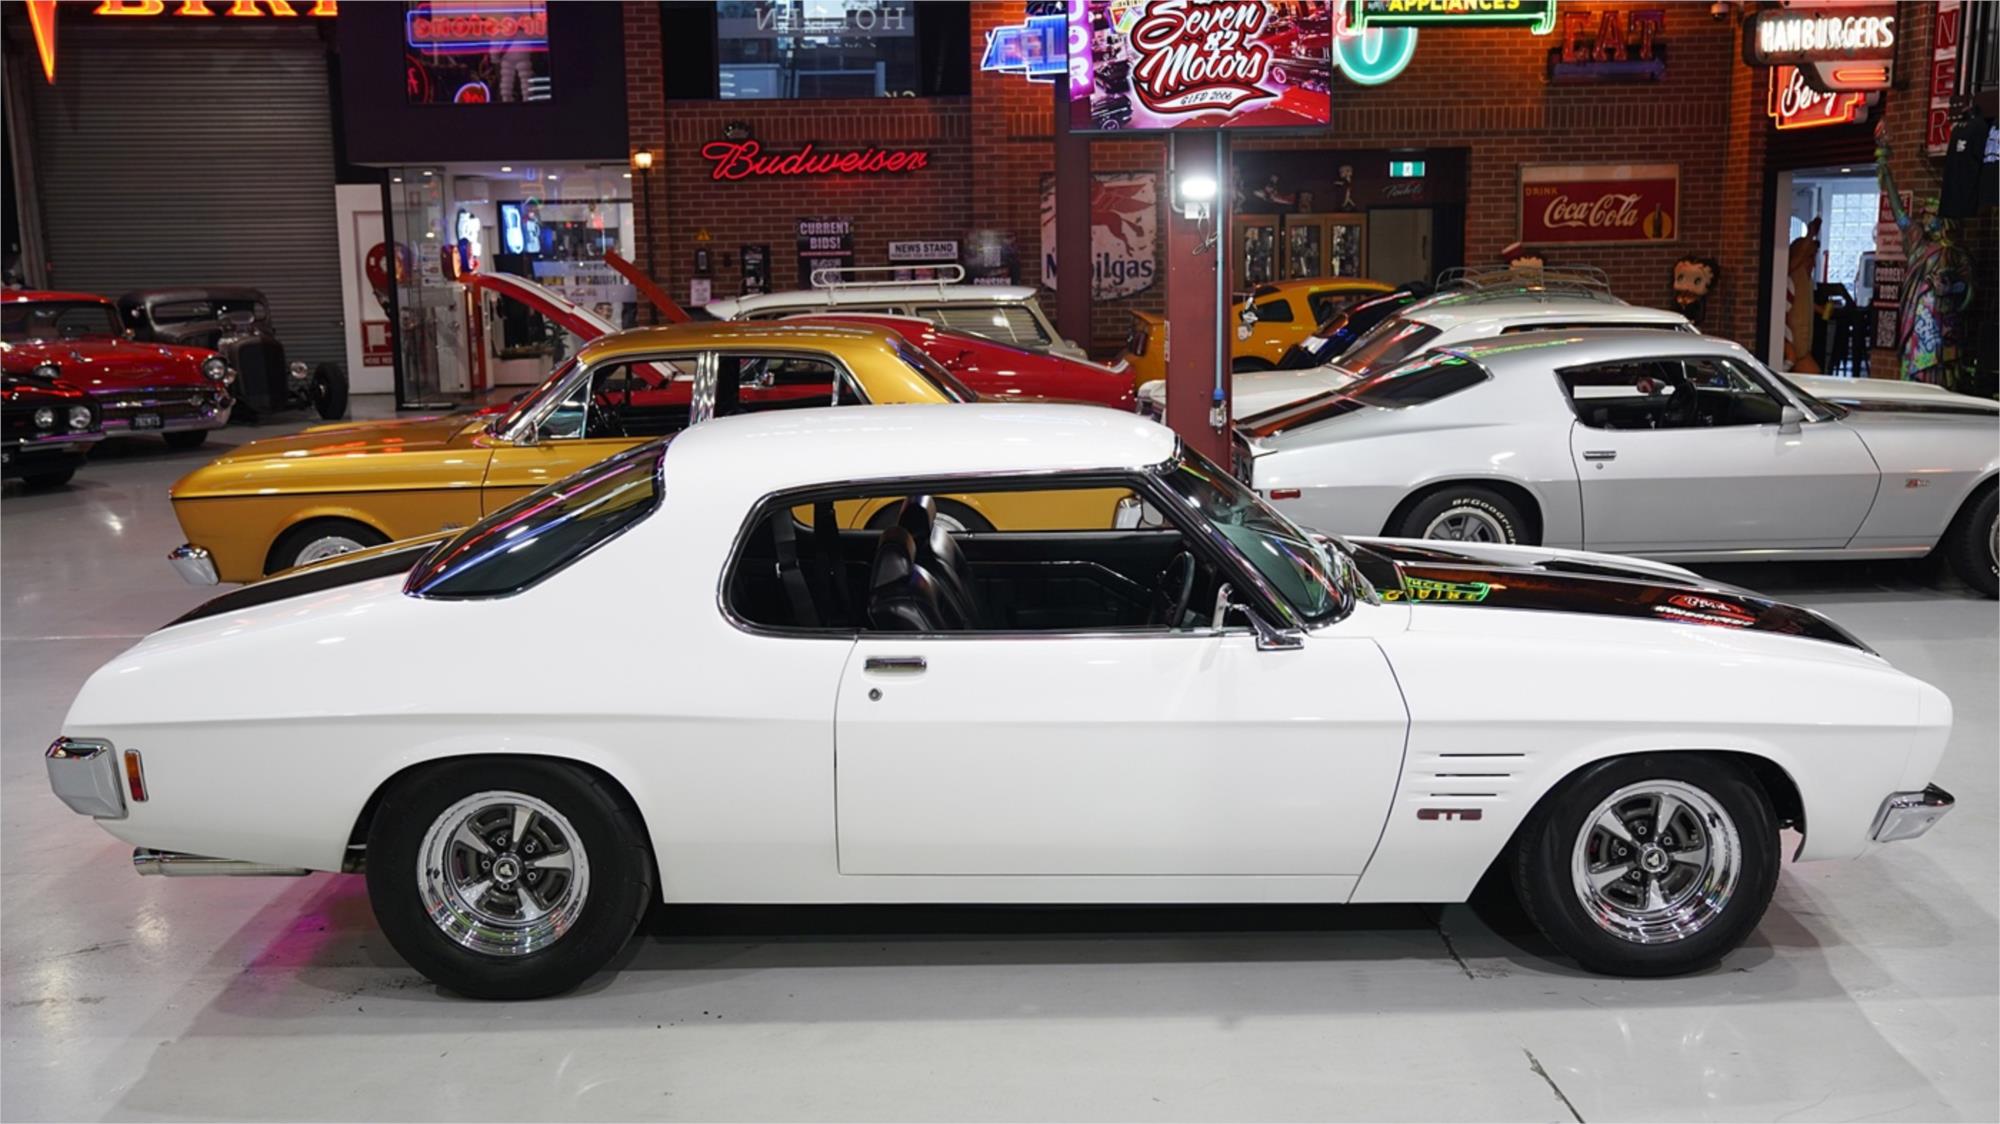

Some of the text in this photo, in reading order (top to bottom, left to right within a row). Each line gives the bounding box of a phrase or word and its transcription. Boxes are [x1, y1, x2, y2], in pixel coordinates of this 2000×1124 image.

[1137, 0, 1260, 50] Seven
[1203, 31, 1240, 51] 82
[1562, 10, 1665, 62] EAT
[1761, 16, 1895, 52] HAMBURGERS
[1141, 44, 1263, 93] Motors
[702, 141, 928, 179] Budweiser
[1525, 187, 1559, 196] DRINK
[1543, 193, 1643, 228] Coca-Cola
[800, 221, 850, 235] CURRENT
[810, 237, 842, 250] BIDS!
[895, 243, 954, 253] NEWS STAND
[1046, 253, 1153, 286] Milgas
